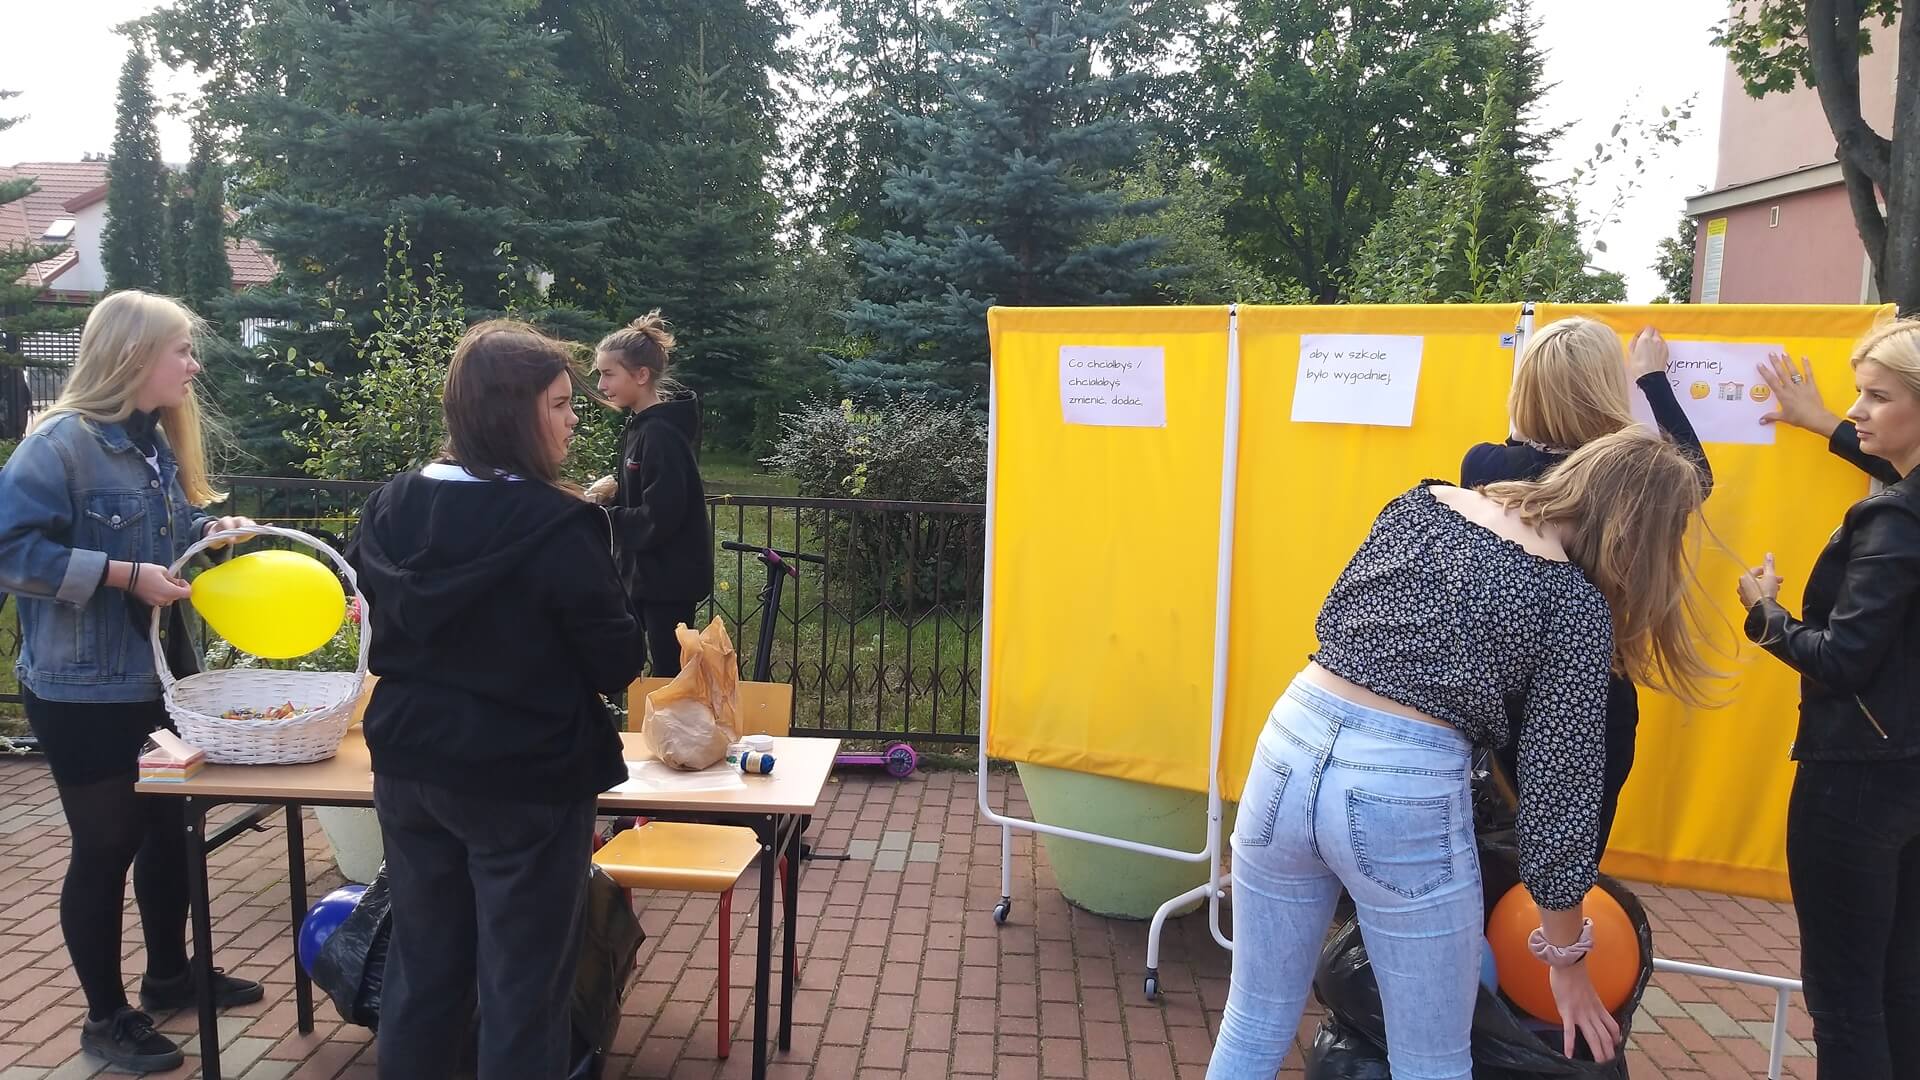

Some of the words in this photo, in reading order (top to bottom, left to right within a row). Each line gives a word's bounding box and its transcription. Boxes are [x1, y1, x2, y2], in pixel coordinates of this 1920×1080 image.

[1068, 358, 1084, 368] Co
[1136, 360, 1143, 369] /
[1309, 348, 1329, 365] aby
[1334, 351, 1344, 359] w
[1348, 348, 1387, 360] szkole
